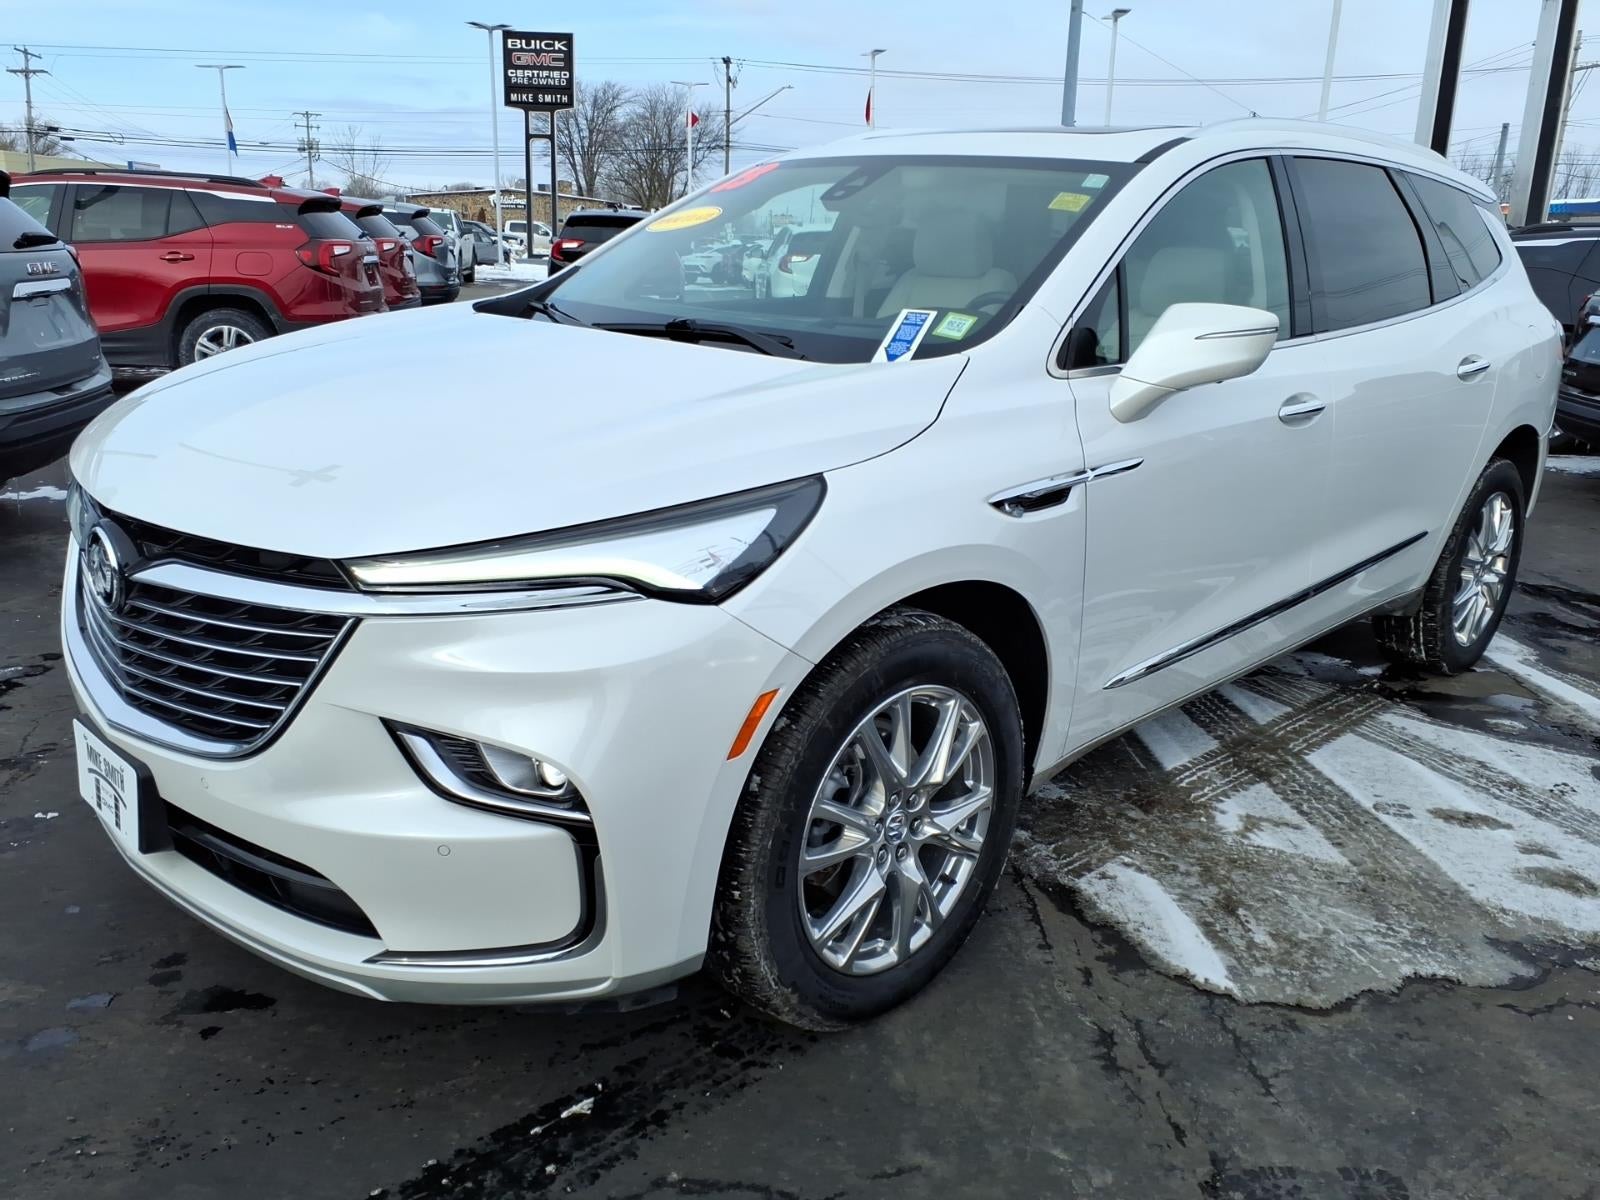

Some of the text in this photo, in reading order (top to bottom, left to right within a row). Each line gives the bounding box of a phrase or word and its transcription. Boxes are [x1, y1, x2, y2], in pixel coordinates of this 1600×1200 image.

[507, 38, 568, 51] BUICK
[511, 52, 564, 67] GMC
[507, 69, 569, 78] CERTIFIED
[511, 77, 566, 86] PRE-OWNED
[510, 93, 568, 103] MIKE SMITH
[86, 741, 125, 793] MIKE SMITH
